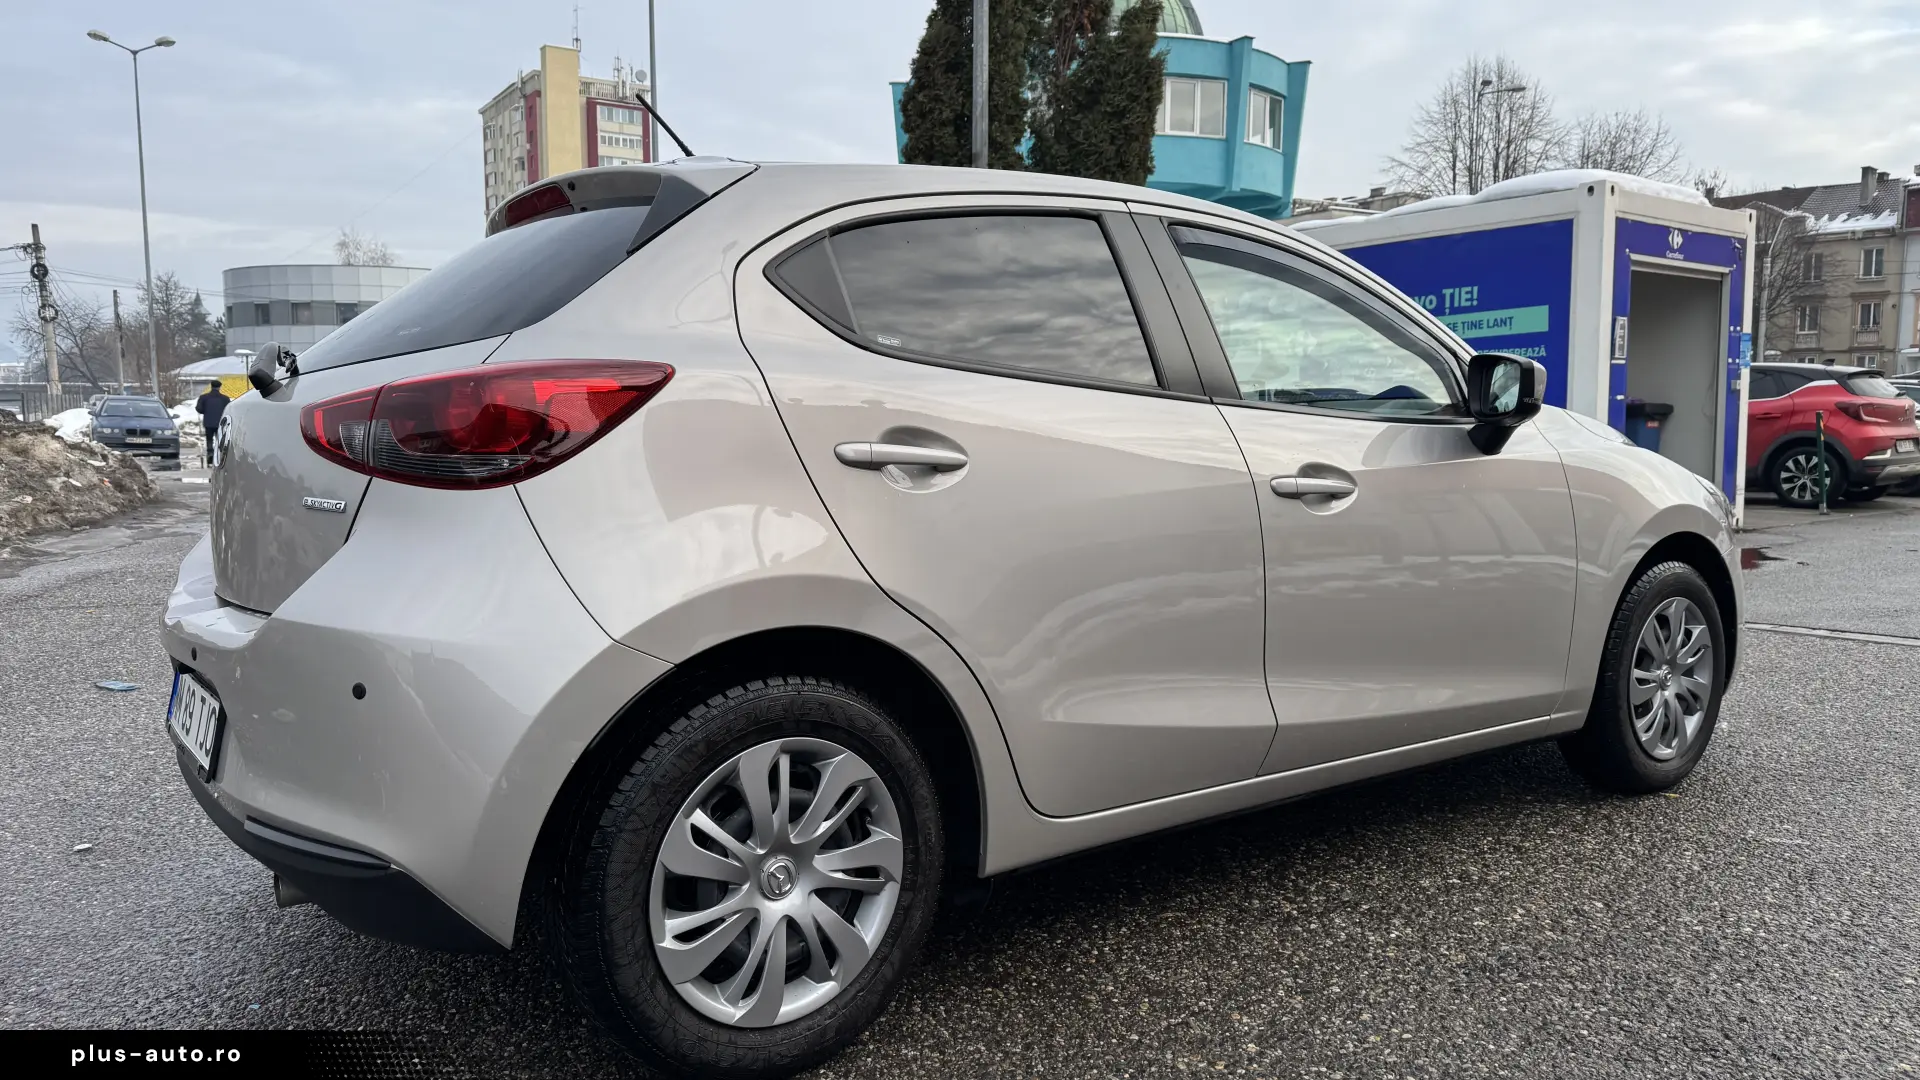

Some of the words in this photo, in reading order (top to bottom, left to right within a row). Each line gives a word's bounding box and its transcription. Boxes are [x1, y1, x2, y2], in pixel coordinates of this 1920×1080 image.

[1442, 286, 1479, 315] ȚIE!
[1461, 319, 1484, 334] ȚINE
[1487, 316, 1514, 331] LANȚ
[195, 694, 217, 758] TJO
